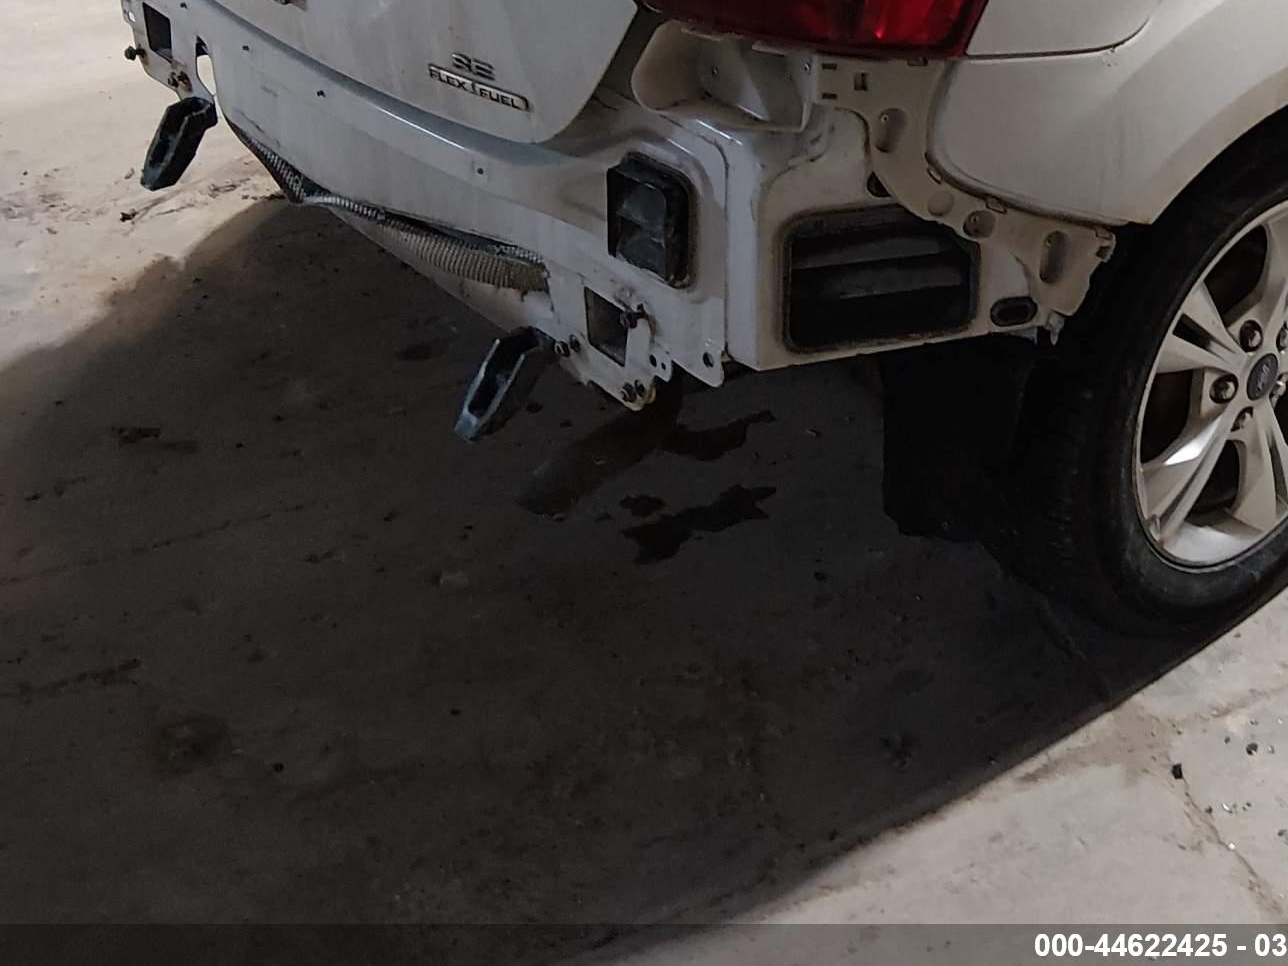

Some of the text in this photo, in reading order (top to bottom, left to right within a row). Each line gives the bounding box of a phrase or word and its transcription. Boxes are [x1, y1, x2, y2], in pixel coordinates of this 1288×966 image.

[451, 52, 496, 82] SE
[428, 68, 523, 112] FLEX FUEL
